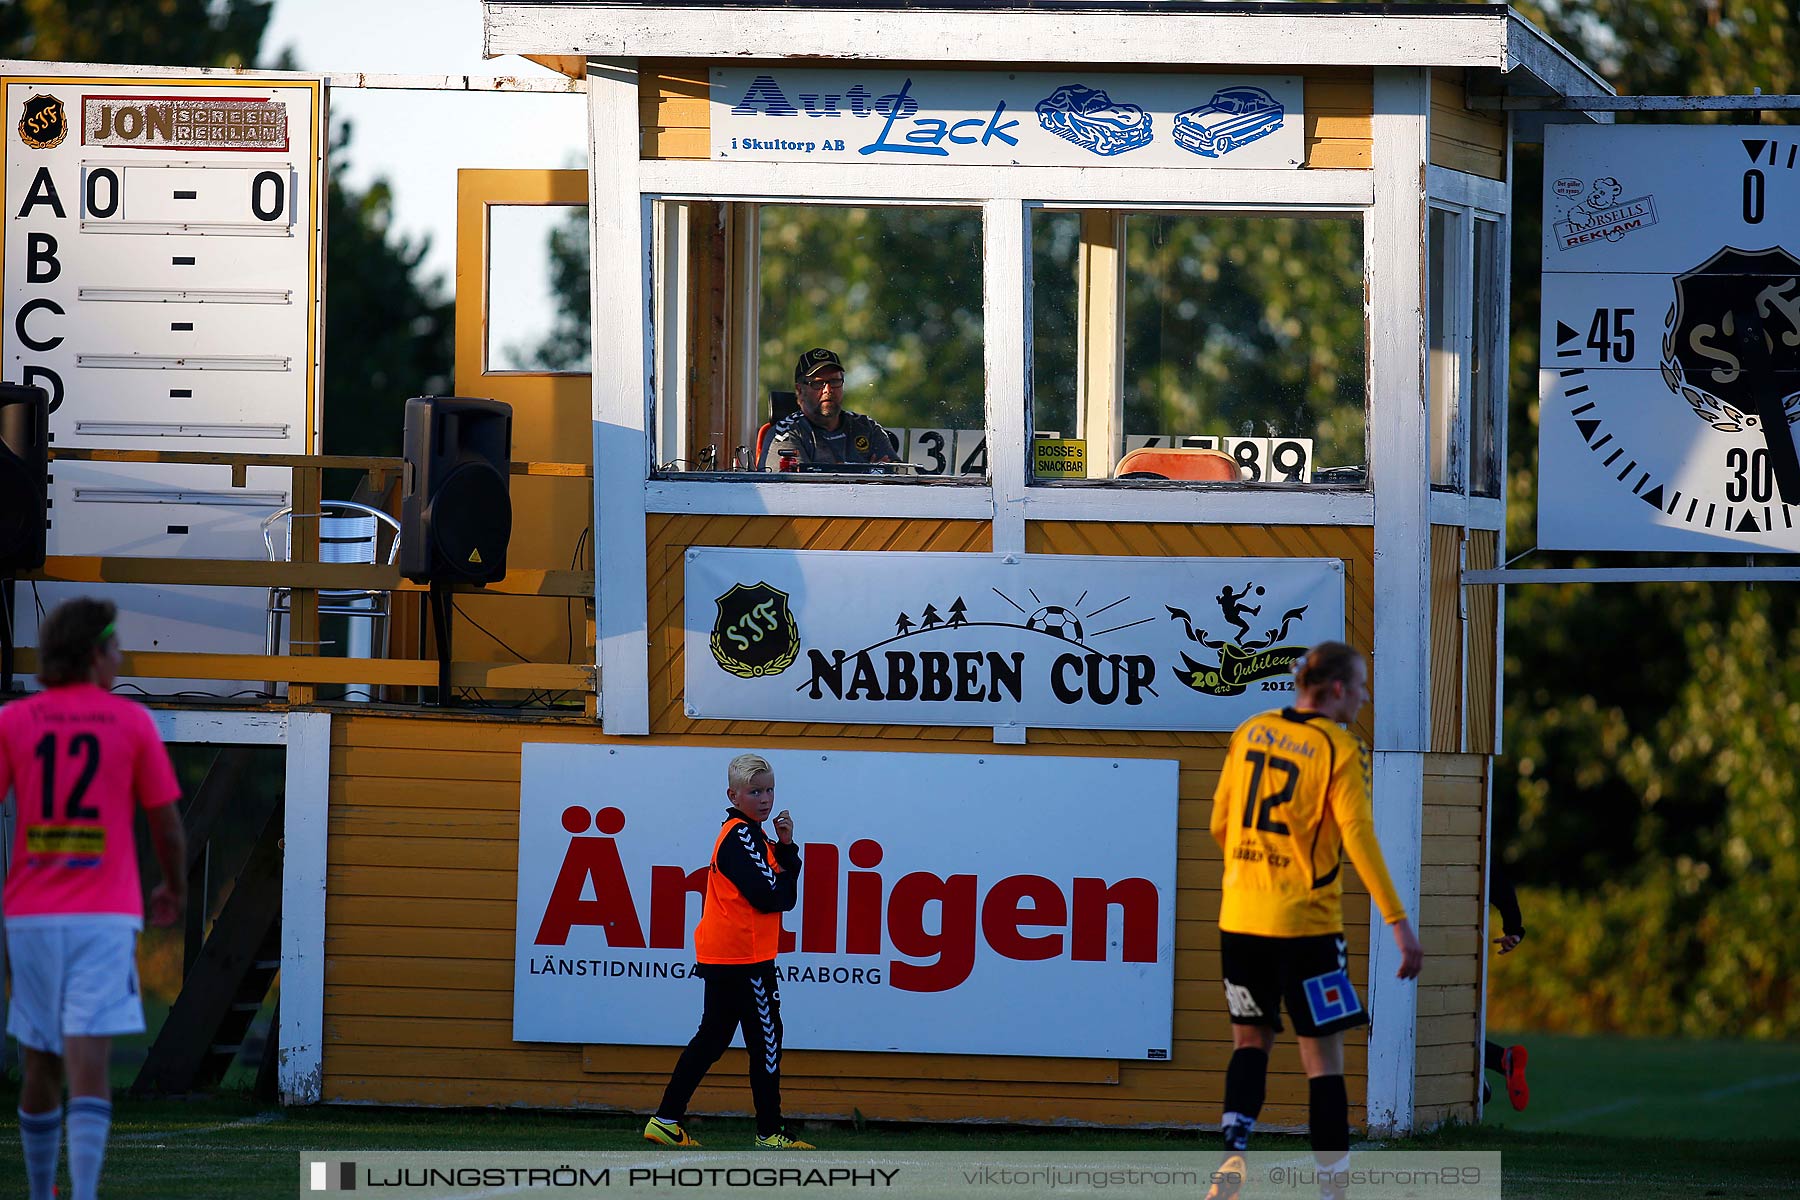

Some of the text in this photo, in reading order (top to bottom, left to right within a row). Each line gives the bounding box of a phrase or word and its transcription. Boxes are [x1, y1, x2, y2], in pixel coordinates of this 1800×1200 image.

[178, 110, 276, 124] SCREEN
[731, 76, 918, 119] Auto
[858, 78, 1020, 156] Lack
[94, 105, 174, 141] JON
[178, 126, 276, 140] REKLAM
[732, 138, 845, 152] i Skultorp AB
[17, 166, 67, 218] A
[87, 168, 119, 218] 0
[252, 171, 285, 221] 0
[1743, 168, 1765, 224] 0
[27, 232, 62, 284] B
[15, 298, 65, 351] C
[1586, 308, 1635, 363] 45
[914, 431, 947, 475] 3
[1038, 446, 1083, 457] BOSSE's
[1038, 461, 1083, 472] SNACKBAR
[1234, 441, 1306, 482] 8 9
[1725, 447, 1774, 503] 30
[807, 648, 1156, 705] NABBEN CUP
[1191, 671, 1219, 687] 20
[1261, 681, 1296, 692] 2012
[34, 732, 101, 820] 12
[1242, 750, 1299, 836] 12
[533, 805, 1159, 993] Änligen
